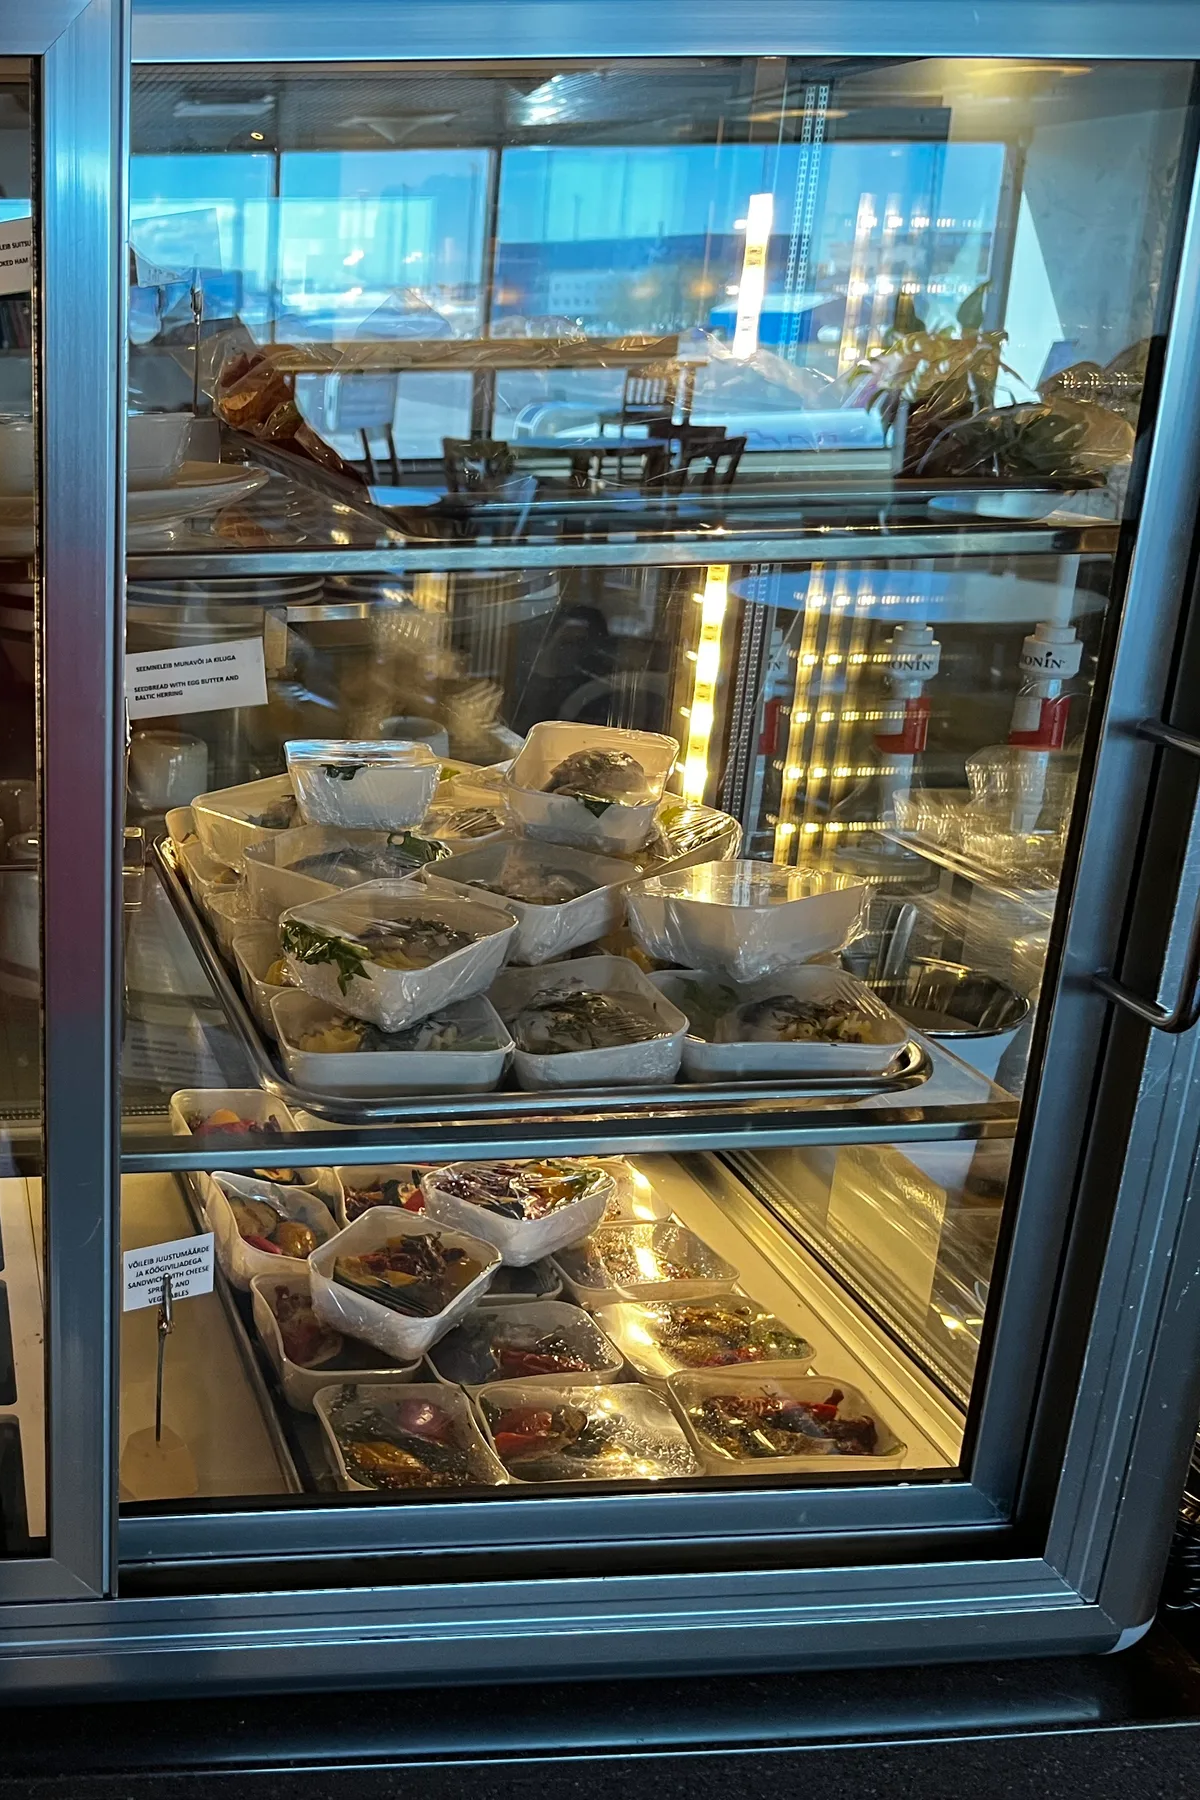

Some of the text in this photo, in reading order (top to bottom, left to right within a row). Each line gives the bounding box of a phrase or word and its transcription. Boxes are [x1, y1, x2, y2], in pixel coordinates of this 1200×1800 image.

[14, 257, 28, 265] HAM
[135, 662, 172, 673] SEEMNELEIB
[213, 654, 236, 663] KILUGA
[134, 683, 169, 693] SEEDBREAD
[170, 680, 186, 688] WITH
[201, 676, 224, 685] BUTTER
[225, 674, 239, 682] AND
[135, 690, 183, 701] BALTIC HERRING
[128, 1258, 154, 1270] VÕILEIB
[185, 1265, 210, 1276] CHEESE
[175, 1279, 190, 1289] AND
